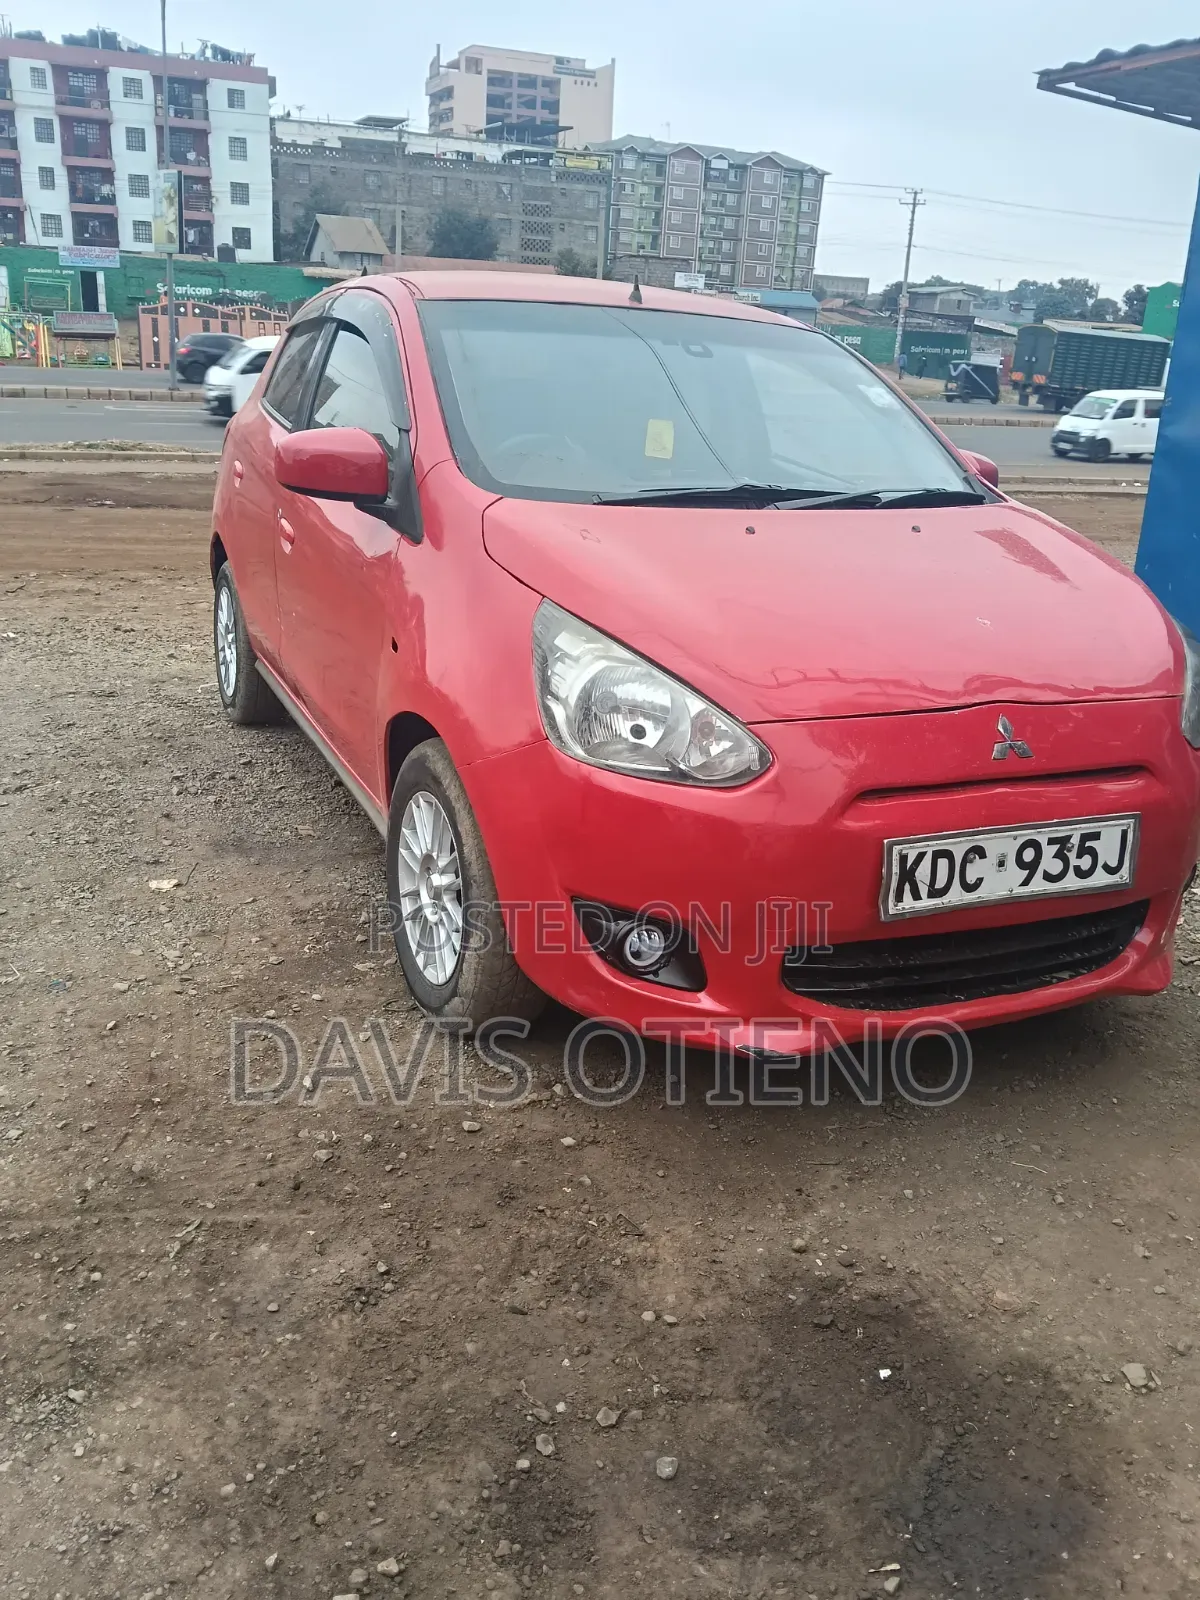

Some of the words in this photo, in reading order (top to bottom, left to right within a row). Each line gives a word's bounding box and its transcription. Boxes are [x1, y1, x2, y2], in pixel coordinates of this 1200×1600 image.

[844, 336, 861, 345] pesa
[894, 844, 988, 903] KDC
[1014, 828, 1129, 887] 935J
